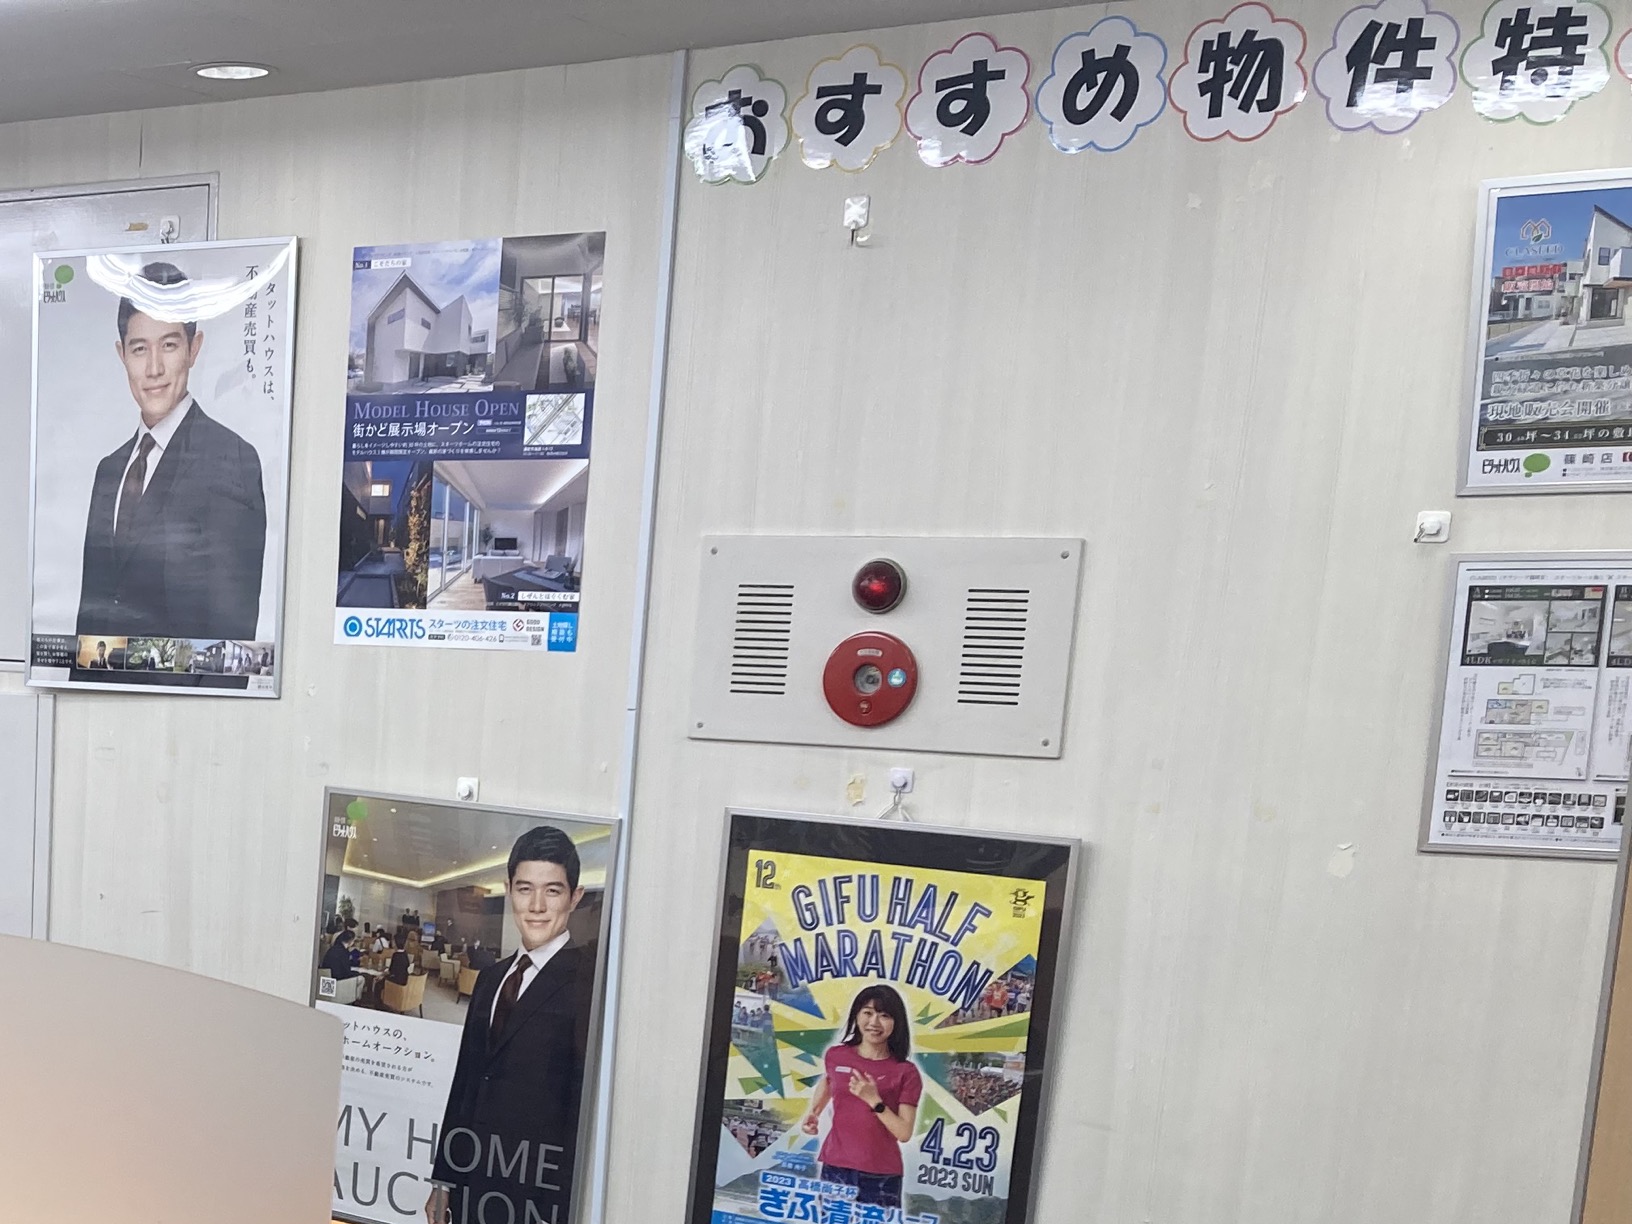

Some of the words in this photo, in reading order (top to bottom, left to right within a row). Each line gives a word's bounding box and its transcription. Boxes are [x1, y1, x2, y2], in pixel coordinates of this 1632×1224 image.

[262, 264, 276, 401] タットハウスは、
[351, 421, 474, 438] 街かど展示場オープン
[1487, 398, 1611, 421] 現地販売会開催
[428, 618, 508, 632] スターツの注文住宅
[791, 873, 880, 932] GIFU
[886, 875, 993, 947] HALF
[778, 928, 994, 1011] MARATHON
[406, 1118, 565, 1193] HOME
[920, 1117, 1001, 1173] 4.23
[765, 1174, 793, 1187] 2023
[917, 1163, 959, 1190] 2023
[961, 1171, 995, 1197] SUN
